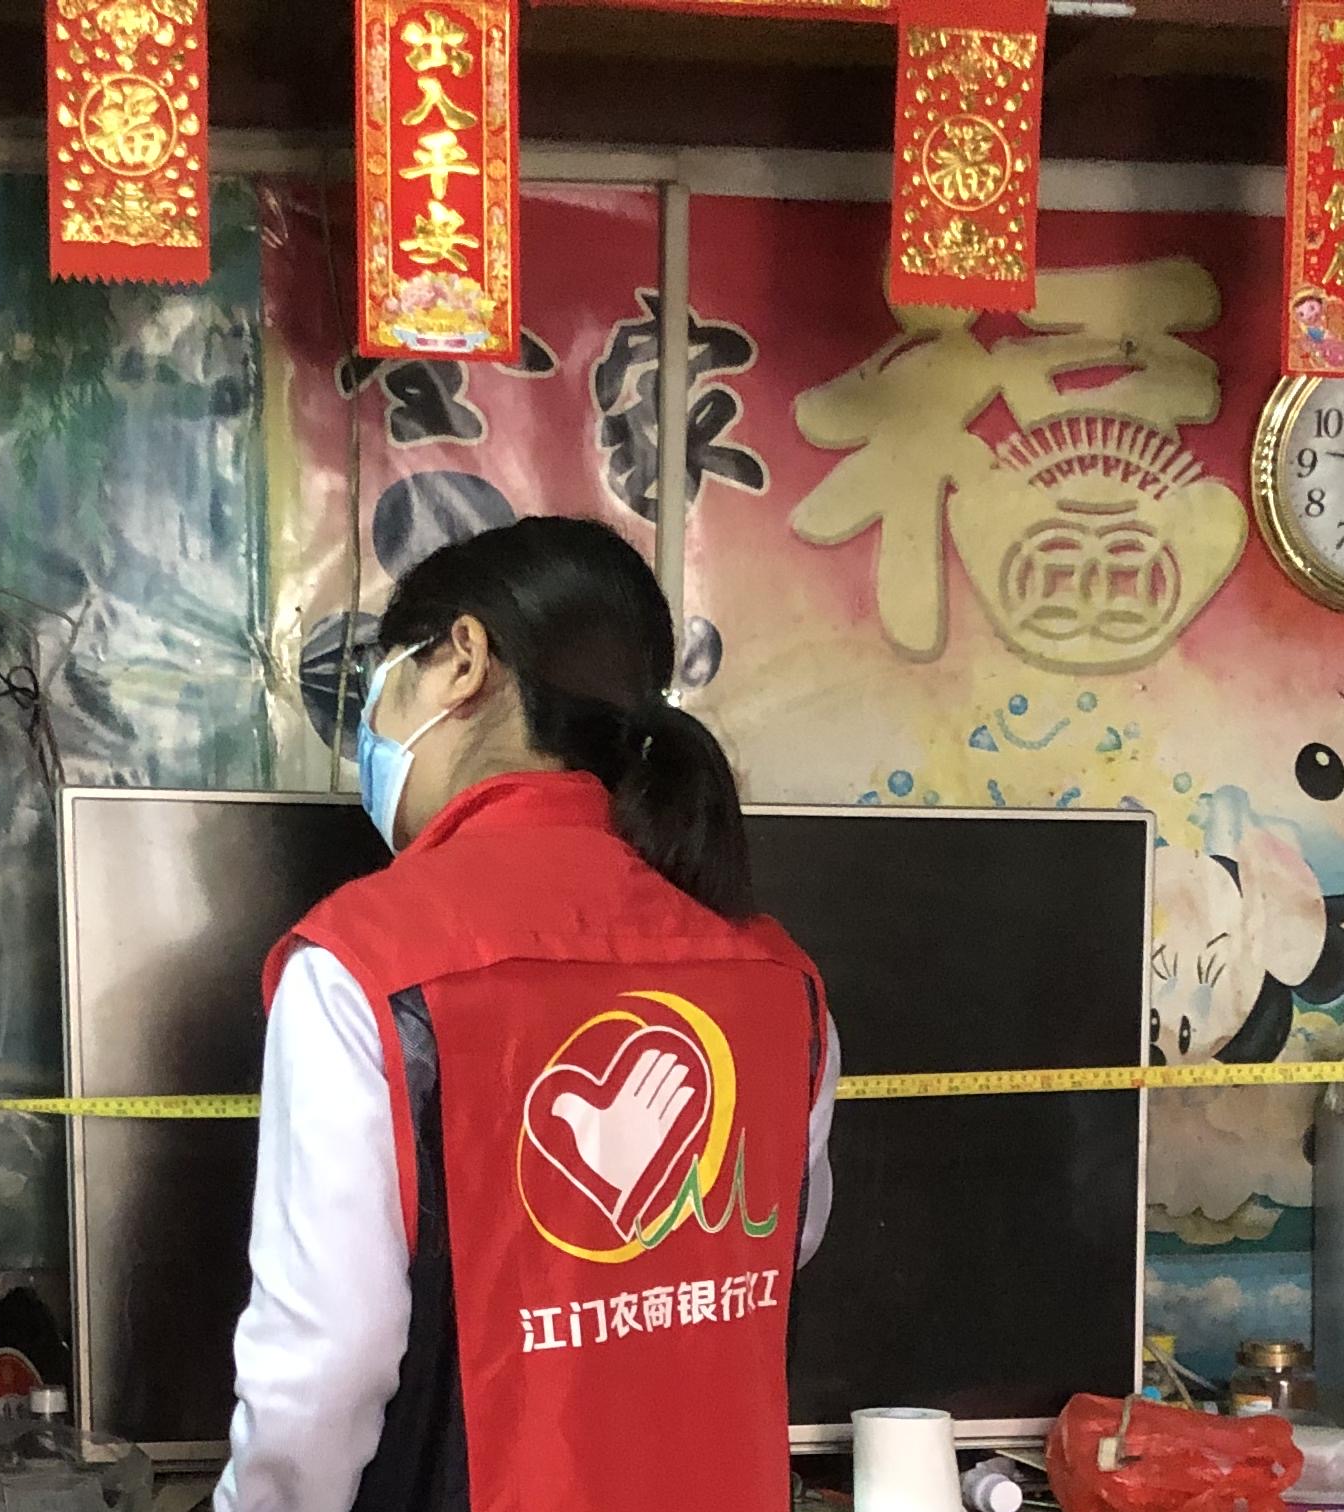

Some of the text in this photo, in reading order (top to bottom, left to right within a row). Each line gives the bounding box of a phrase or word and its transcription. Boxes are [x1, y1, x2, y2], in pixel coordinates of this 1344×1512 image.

[399, 15, 481, 273] 出入平安
[1313, 408, 1344, 438] 10
[1296, 448, 1318, 478] 9
[1304, 488, 1326, 517] 8
